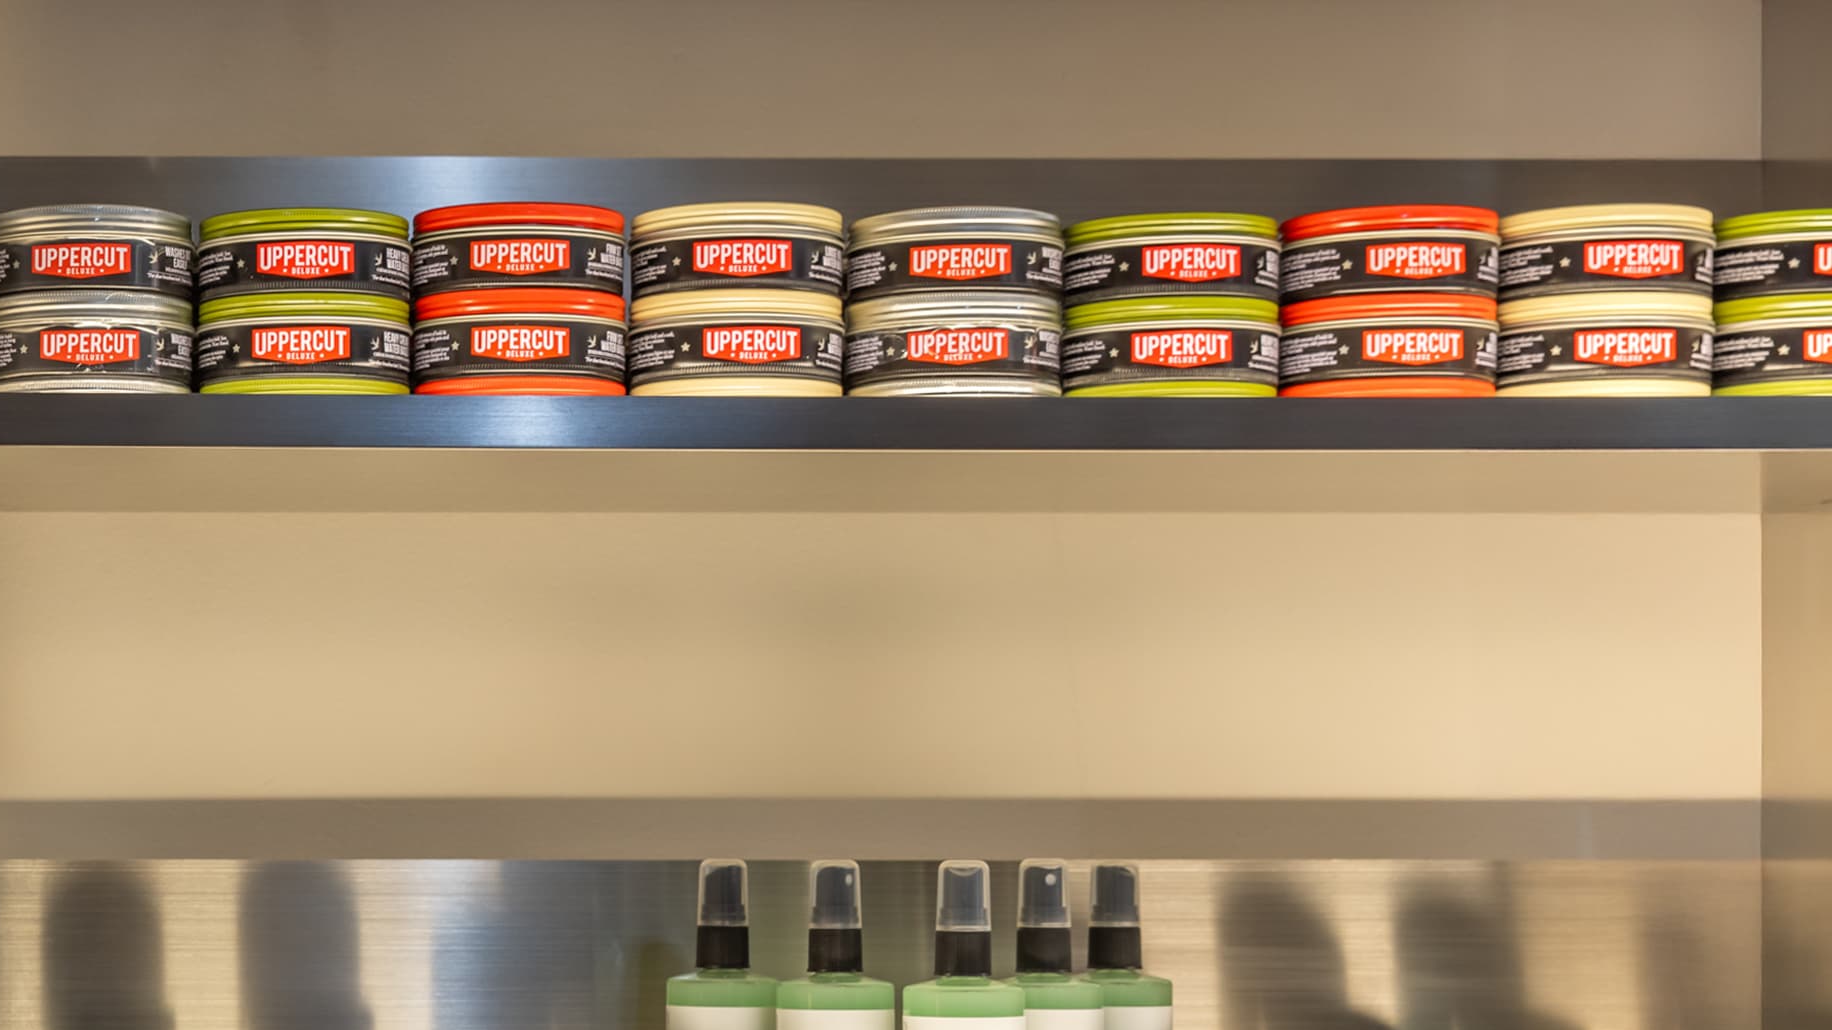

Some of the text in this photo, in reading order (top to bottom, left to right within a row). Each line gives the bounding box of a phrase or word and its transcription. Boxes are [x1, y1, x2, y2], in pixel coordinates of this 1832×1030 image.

[34, 246, 128, 272] UPPERCUT
[260, 244, 352, 271] UPPERCUT
[473, 242, 567, 268] UPPERCUT
[696, 243, 789, 269] UPPERCUT
[912, 247, 1008, 273] UPPERCUT
[1145, 248, 1237, 274] UPPERCUT
[1369, 245, 1463, 272] UPPERCUT
[1588, 244, 1680, 271] UPPERCUT
[43, 332, 136, 357] UPPERCUT
[254, 329, 346, 356] UPPERCUT
[474, 329, 566, 354] UPPERCUT
[706, 329, 797, 356] UPPERCUT
[910, 331, 1005, 358] UPPERCUT
[1135, 333, 1228, 360] UPPERCUT
[1366, 332, 1460, 357] UPPERCUT
[1578, 332, 1673, 358] UPPERCUT
